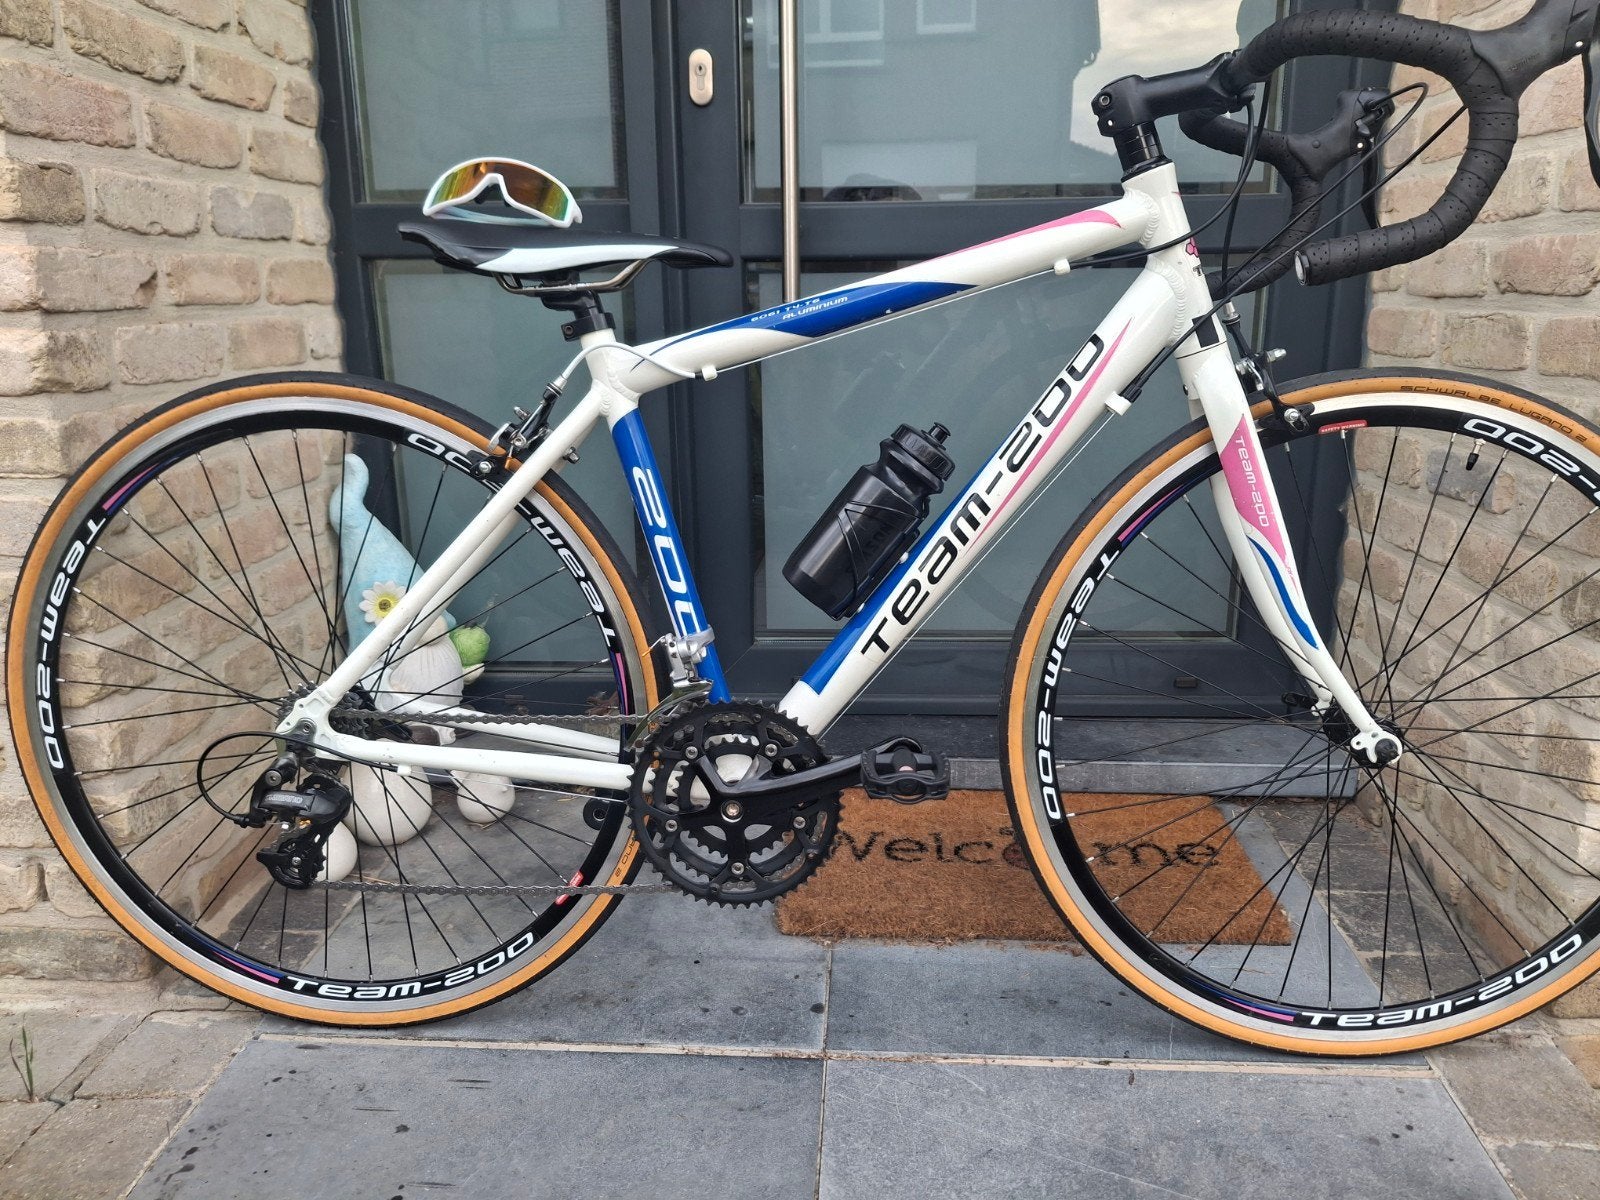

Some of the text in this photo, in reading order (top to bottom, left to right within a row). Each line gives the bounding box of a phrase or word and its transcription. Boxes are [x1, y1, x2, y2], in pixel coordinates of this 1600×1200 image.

[751, 309, 780, 322] 6061
[782, 296, 848, 320] ALUMINIUM
[1400, 385, 1502, 405] SCHWALBE
[1508, 402, 1573, 434] LUGANO
[861, 334, 1104, 654] Team-200
[1235, 435, 1270, 527] Team-200
[36, 517, 106, 769] Team-200
[1037, 550, 1119, 820] Team-200
[286, 931, 535, 999] Team-200
[1301, 933, 1583, 1027] Team-200
